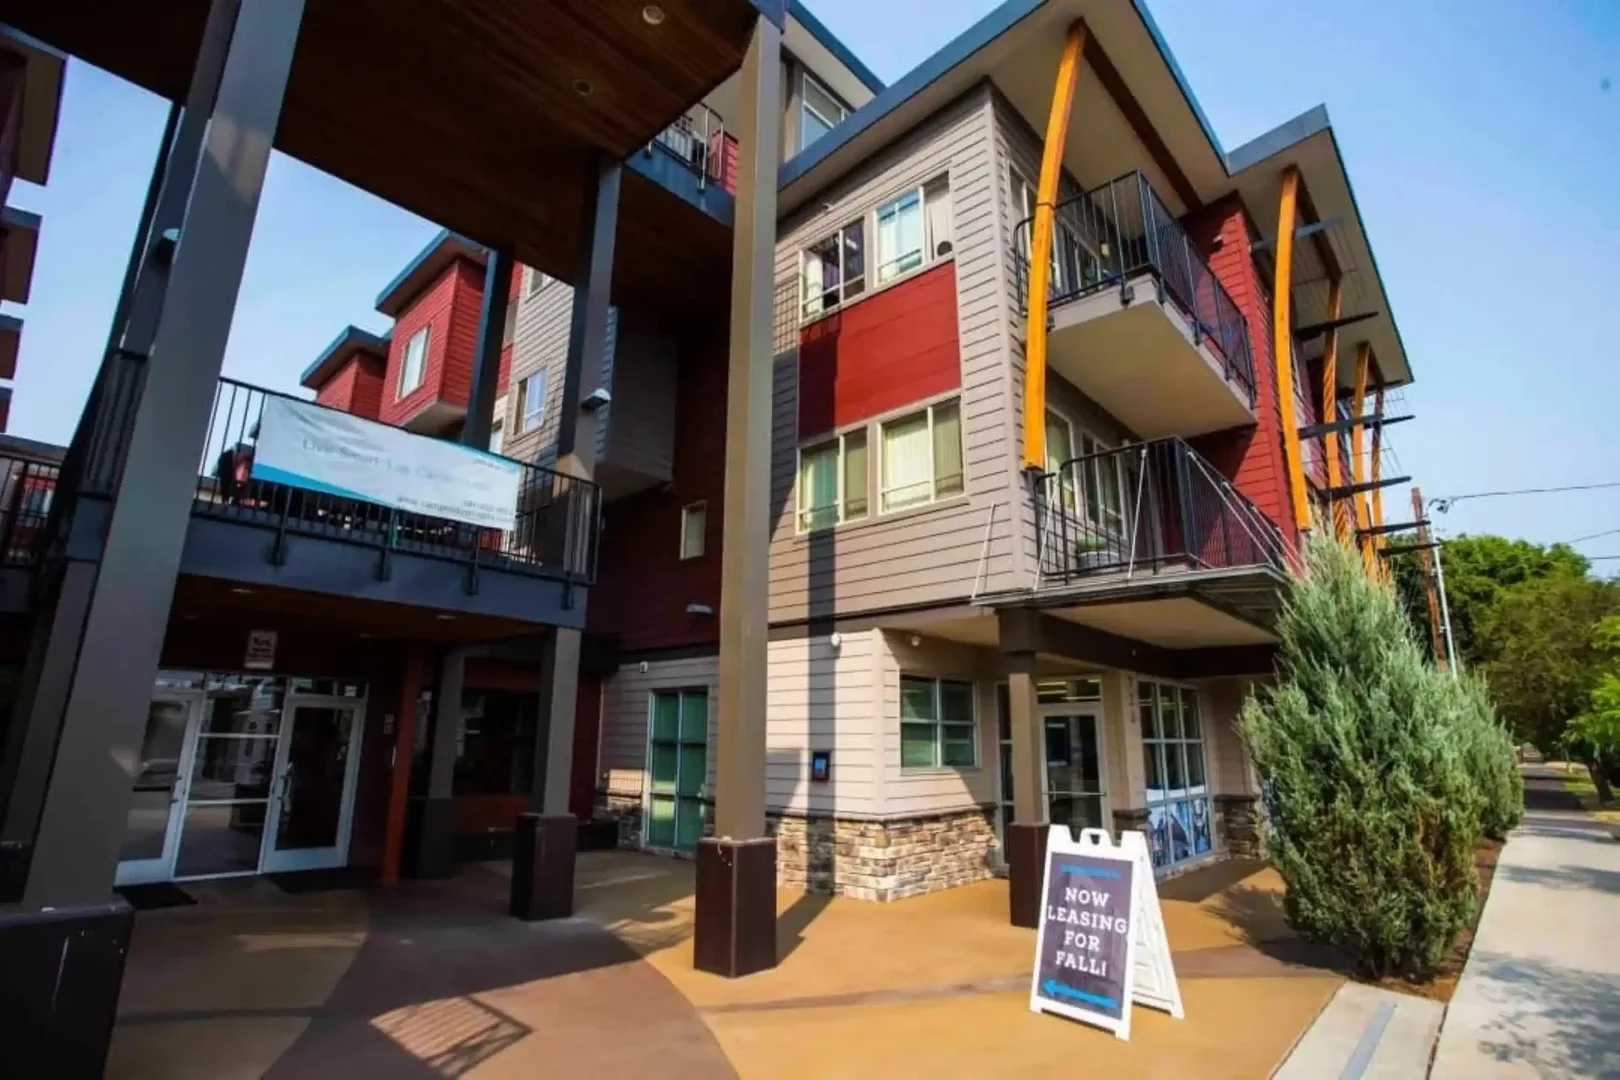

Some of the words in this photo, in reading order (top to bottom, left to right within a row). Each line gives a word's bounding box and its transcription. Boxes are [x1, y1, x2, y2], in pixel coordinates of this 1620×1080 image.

[1065, 887, 1110, 907] NOW
[1047, 905, 1127, 934] LEASING
[1064, 929, 1100, 952] FOR
[1055, 950, 1107, 977] FALL!
